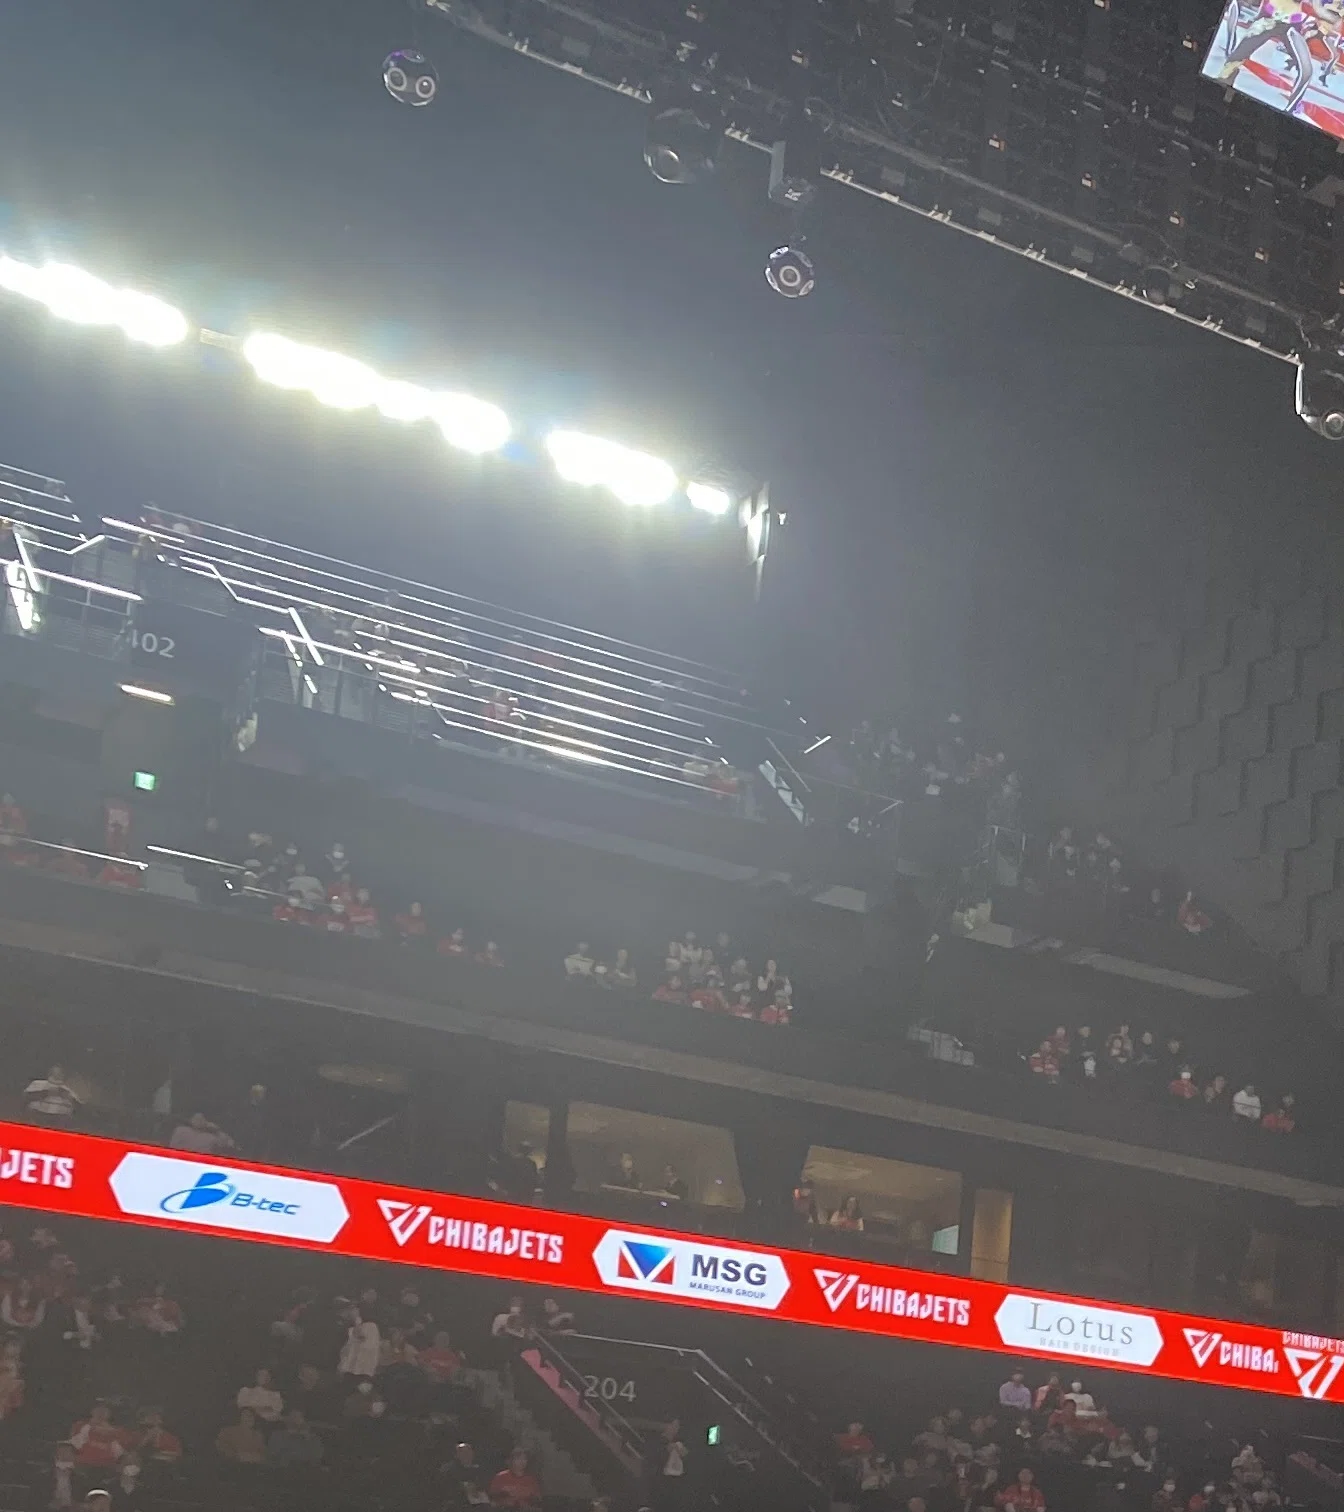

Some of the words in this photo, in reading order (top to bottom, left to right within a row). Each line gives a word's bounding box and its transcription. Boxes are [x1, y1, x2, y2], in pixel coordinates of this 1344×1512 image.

[230, 1193, 301, 1215] B-tec
[428, 1215, 564, 1263] CHIBAJETS
[691, 1254, 767, 1286] MSG
[689, 1281, 733, 1295] MARUSAN
[735, 1288, 766, 1300] GROUP
[856, 1283, 970, 1326] CHIBAJETS
[1028, 1302, 1133, 1345] Lotus
[584, 1375, 636, 1402] 204
